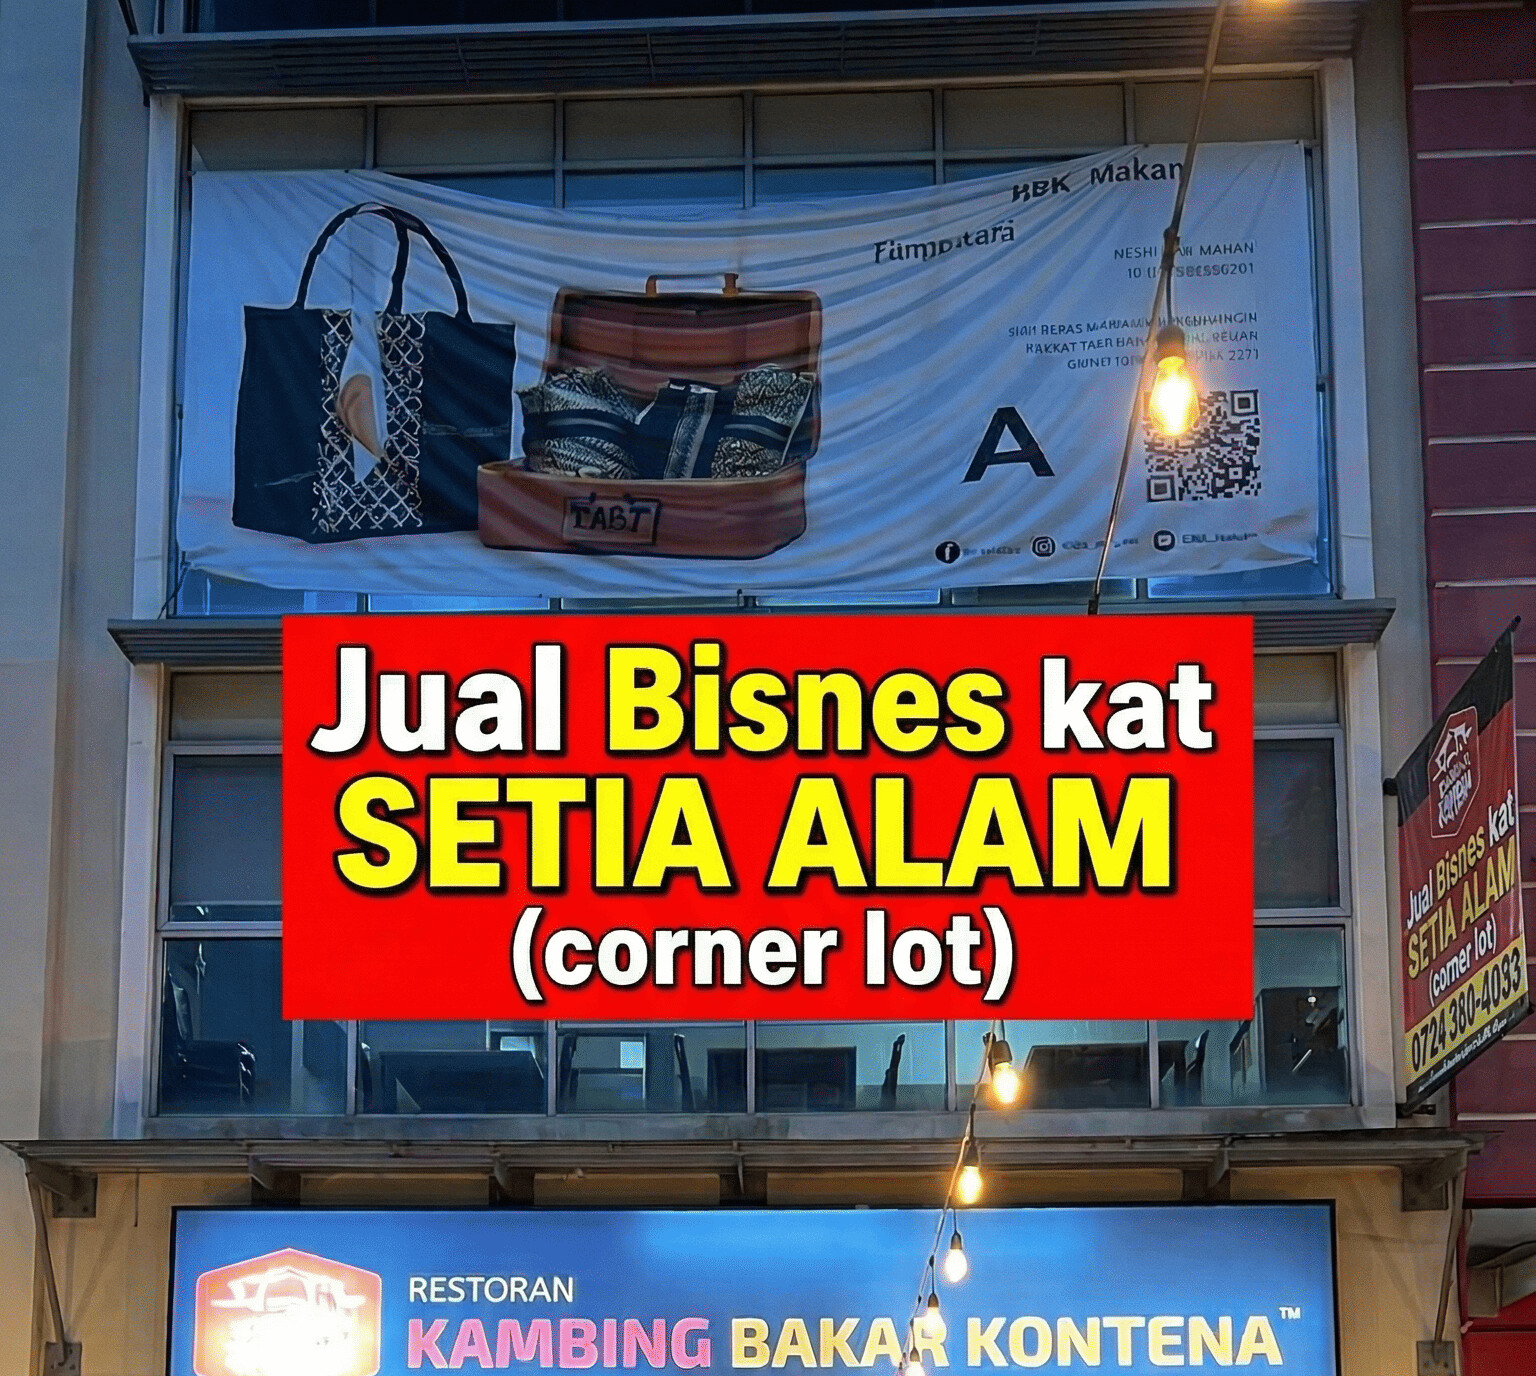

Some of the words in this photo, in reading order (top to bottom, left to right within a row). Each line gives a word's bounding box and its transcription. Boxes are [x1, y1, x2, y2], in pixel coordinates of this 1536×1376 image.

[1090, 157, 1184, 185] Makan
[1199, 242, 1255, 257] MAHAN
[961, 405, 1056, 484] A
[1407, 868, 1434, 931] Jual
[1436, 825, 1486, 900] Bisnes
[1488, 788, 1515, 848] kat
[1408, 897, 1457, 979] SETIA
[1461, 834, 1516, 932] ALAM
[1429, 942, 1472, 1008] (corner
[1474, 912, 1497, 961] lot)
[1411, 1008, 1447, 1073] 0724
[408, 1276, 574, 1304] RESTORAN
[406, 1317, 712, 1370] KAMBING
[730, 1317, 950, 1369] BAKAR
[966, 1314, 1285, 1369] KONTENA
